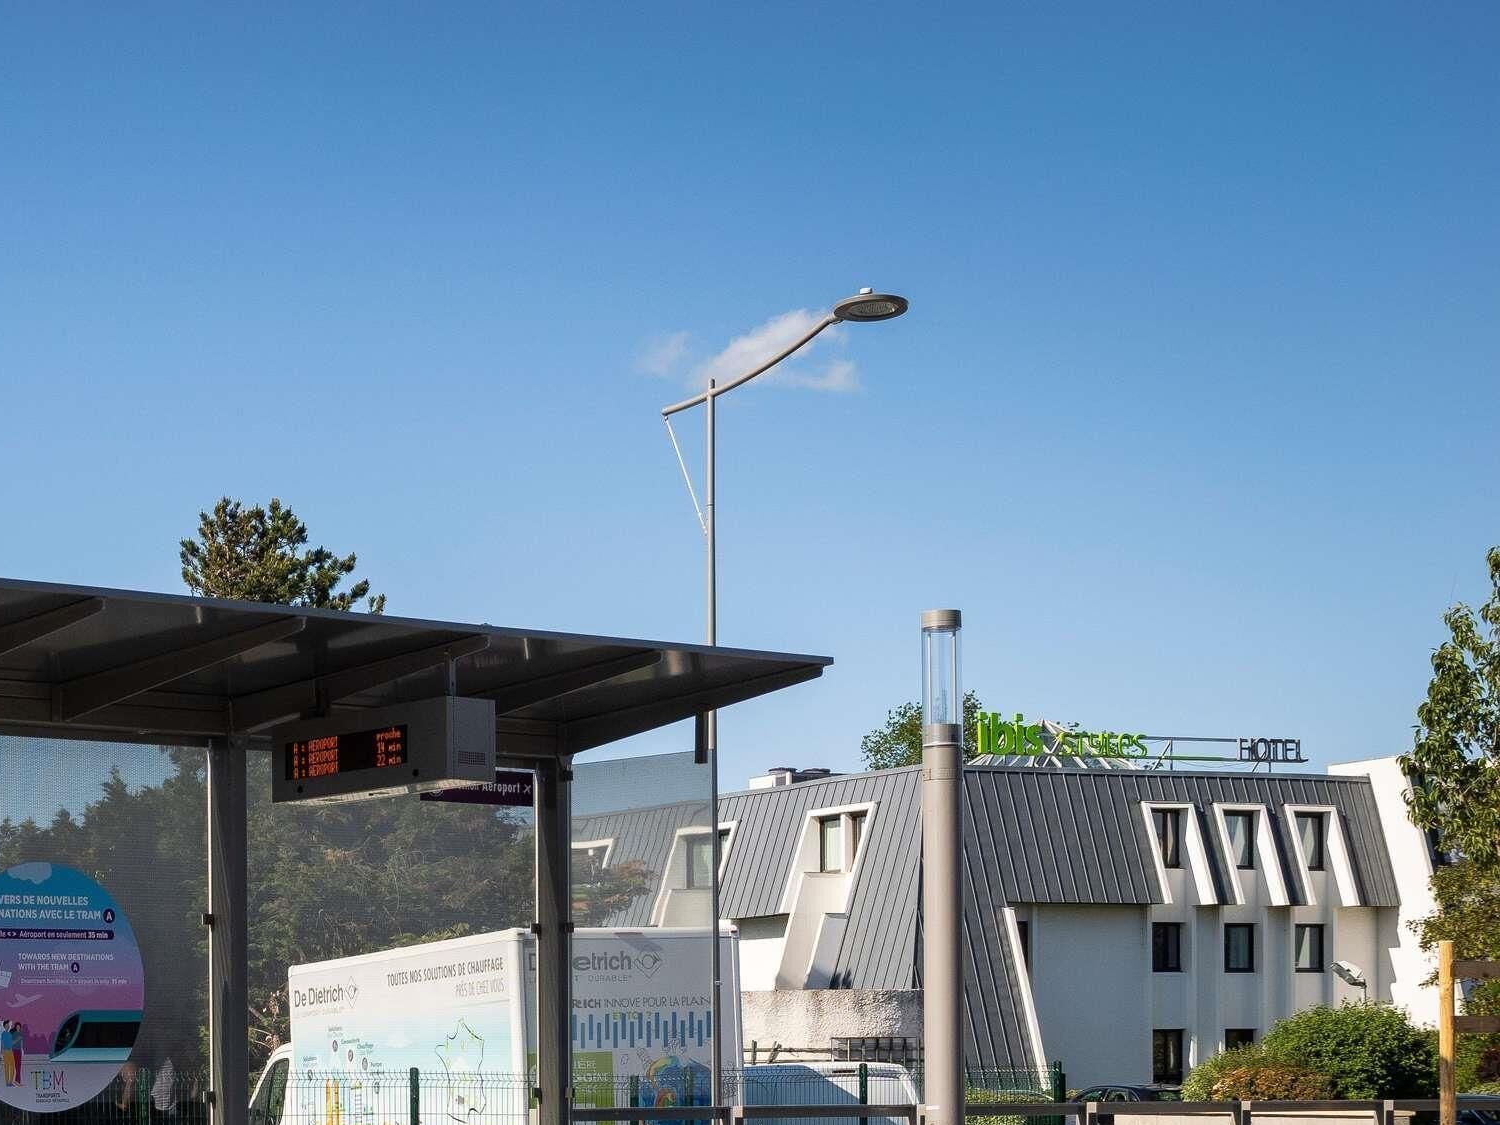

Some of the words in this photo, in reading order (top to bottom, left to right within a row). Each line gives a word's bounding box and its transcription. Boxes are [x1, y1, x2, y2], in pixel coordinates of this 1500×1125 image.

[977, 711, 1045, 756] ibis
[1237, 738, 1308, 763] HOTEL
[22, 895, 35, 905] DE
[36, 895, 89, 906] NOUVELLES
[39, 909, 63, 919] AVEC
[63, 910, 75, 920] LE
[76, 910, 101, 920] TRAM
[106, 911, 113, 921] A
[67, 953, 114, 961] DESTINATIONS
[386, 971, 408, 987] TOUTES
[409, 969, 422, 984] NOS
[423, 963, 457, 982] SOLUTIONS
[458, 962, 466, 976] DE
[467, 957, 504, 975] CHAUFFAGE
[294, 990, 307, 1008] De
[308, 984, 344, 1005] Dietrich
[604, 997, 640, 1008] INNOVE
[642, 996, 667, 1008] POUR
[669, 996, 680, 1007] LA
[30, 1070, 68, 1094] TBM
